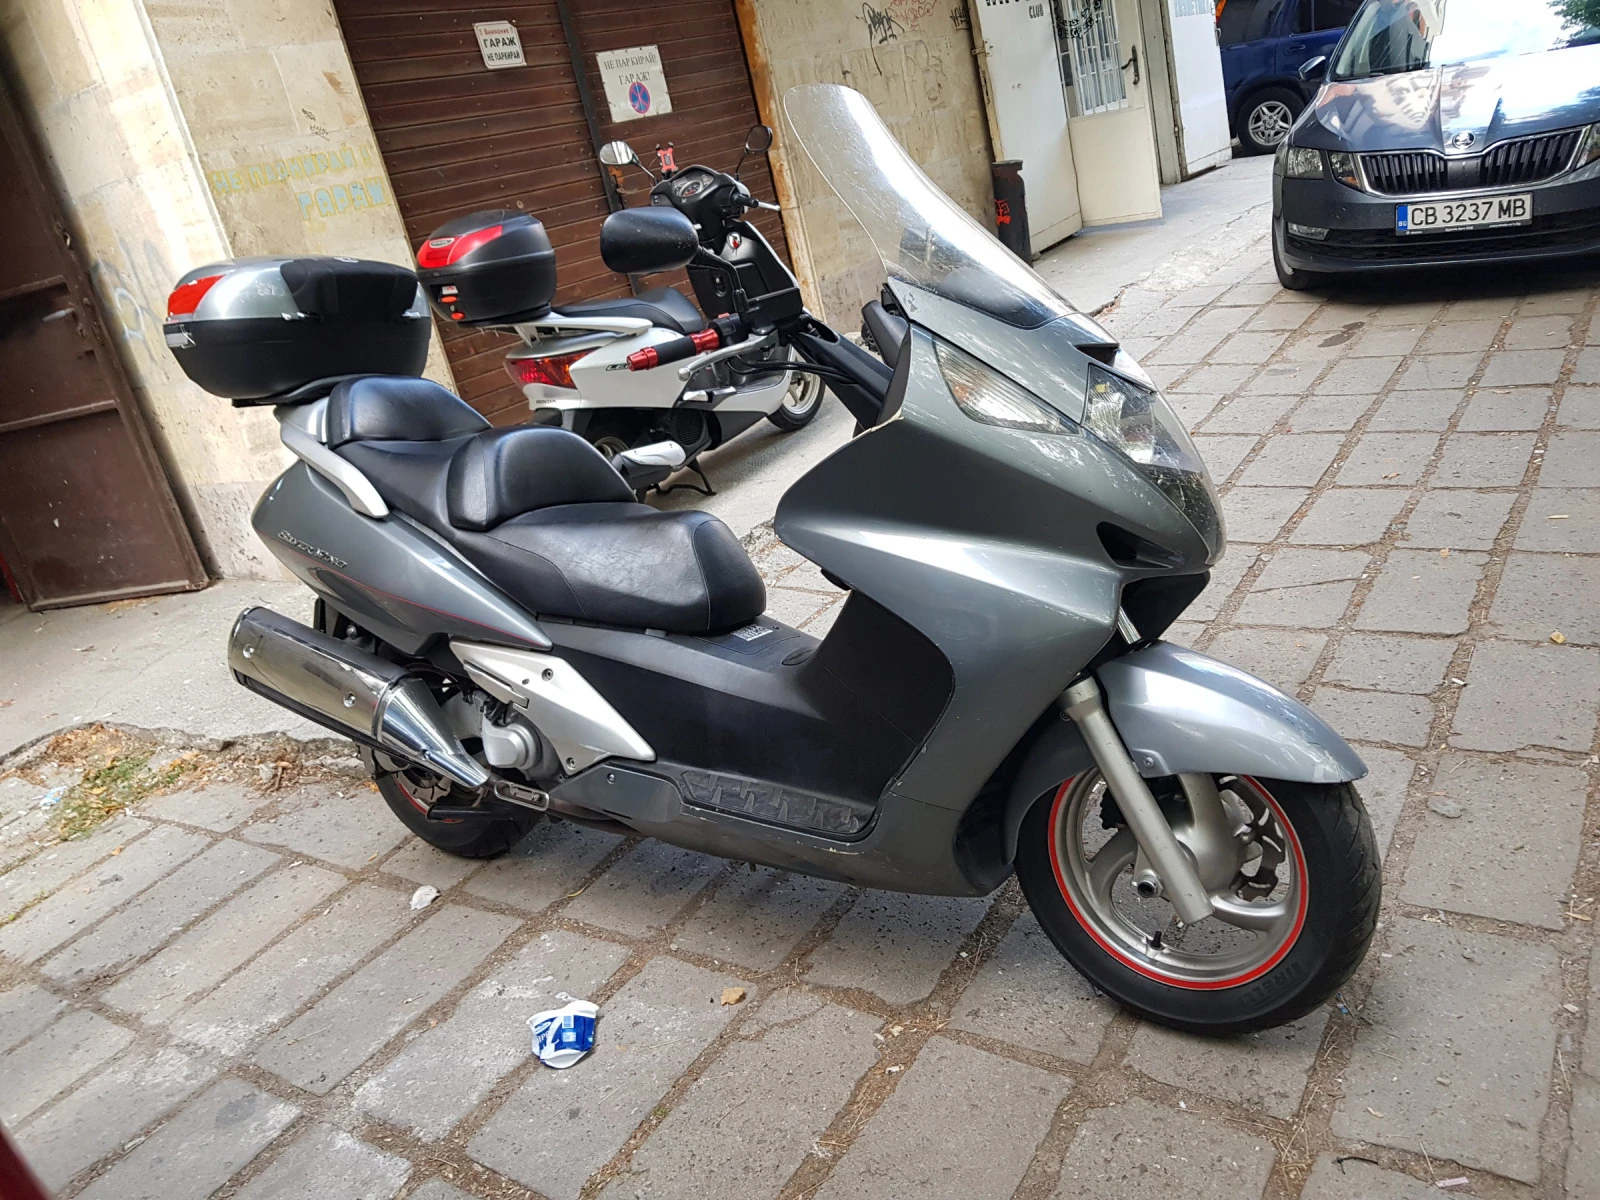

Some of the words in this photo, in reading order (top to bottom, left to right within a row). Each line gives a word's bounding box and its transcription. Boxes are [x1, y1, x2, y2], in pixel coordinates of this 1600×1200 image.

[1029, 4, 1044, 18] CLUB
[483, 36, 517, 48] ГАРАЖ
[487, 53, 495, 61] НЕ
[495, 49, 521, 60] ПАРКИРАЙ
[604, 60, 615, 70] НЕ
[615, 52, 657, 68] ПАРКИРАЙ!
[618, 71, 651, 85] ГАРАЖ!
[209, 170, 244, 195] НЕ
[296, 176, 388, 220] ГАРАЖ
[1411, 206, 1438, 226] CB
[1442, 201, 1494, 224] 3237
[1498, 198, 1526, 219] MB
